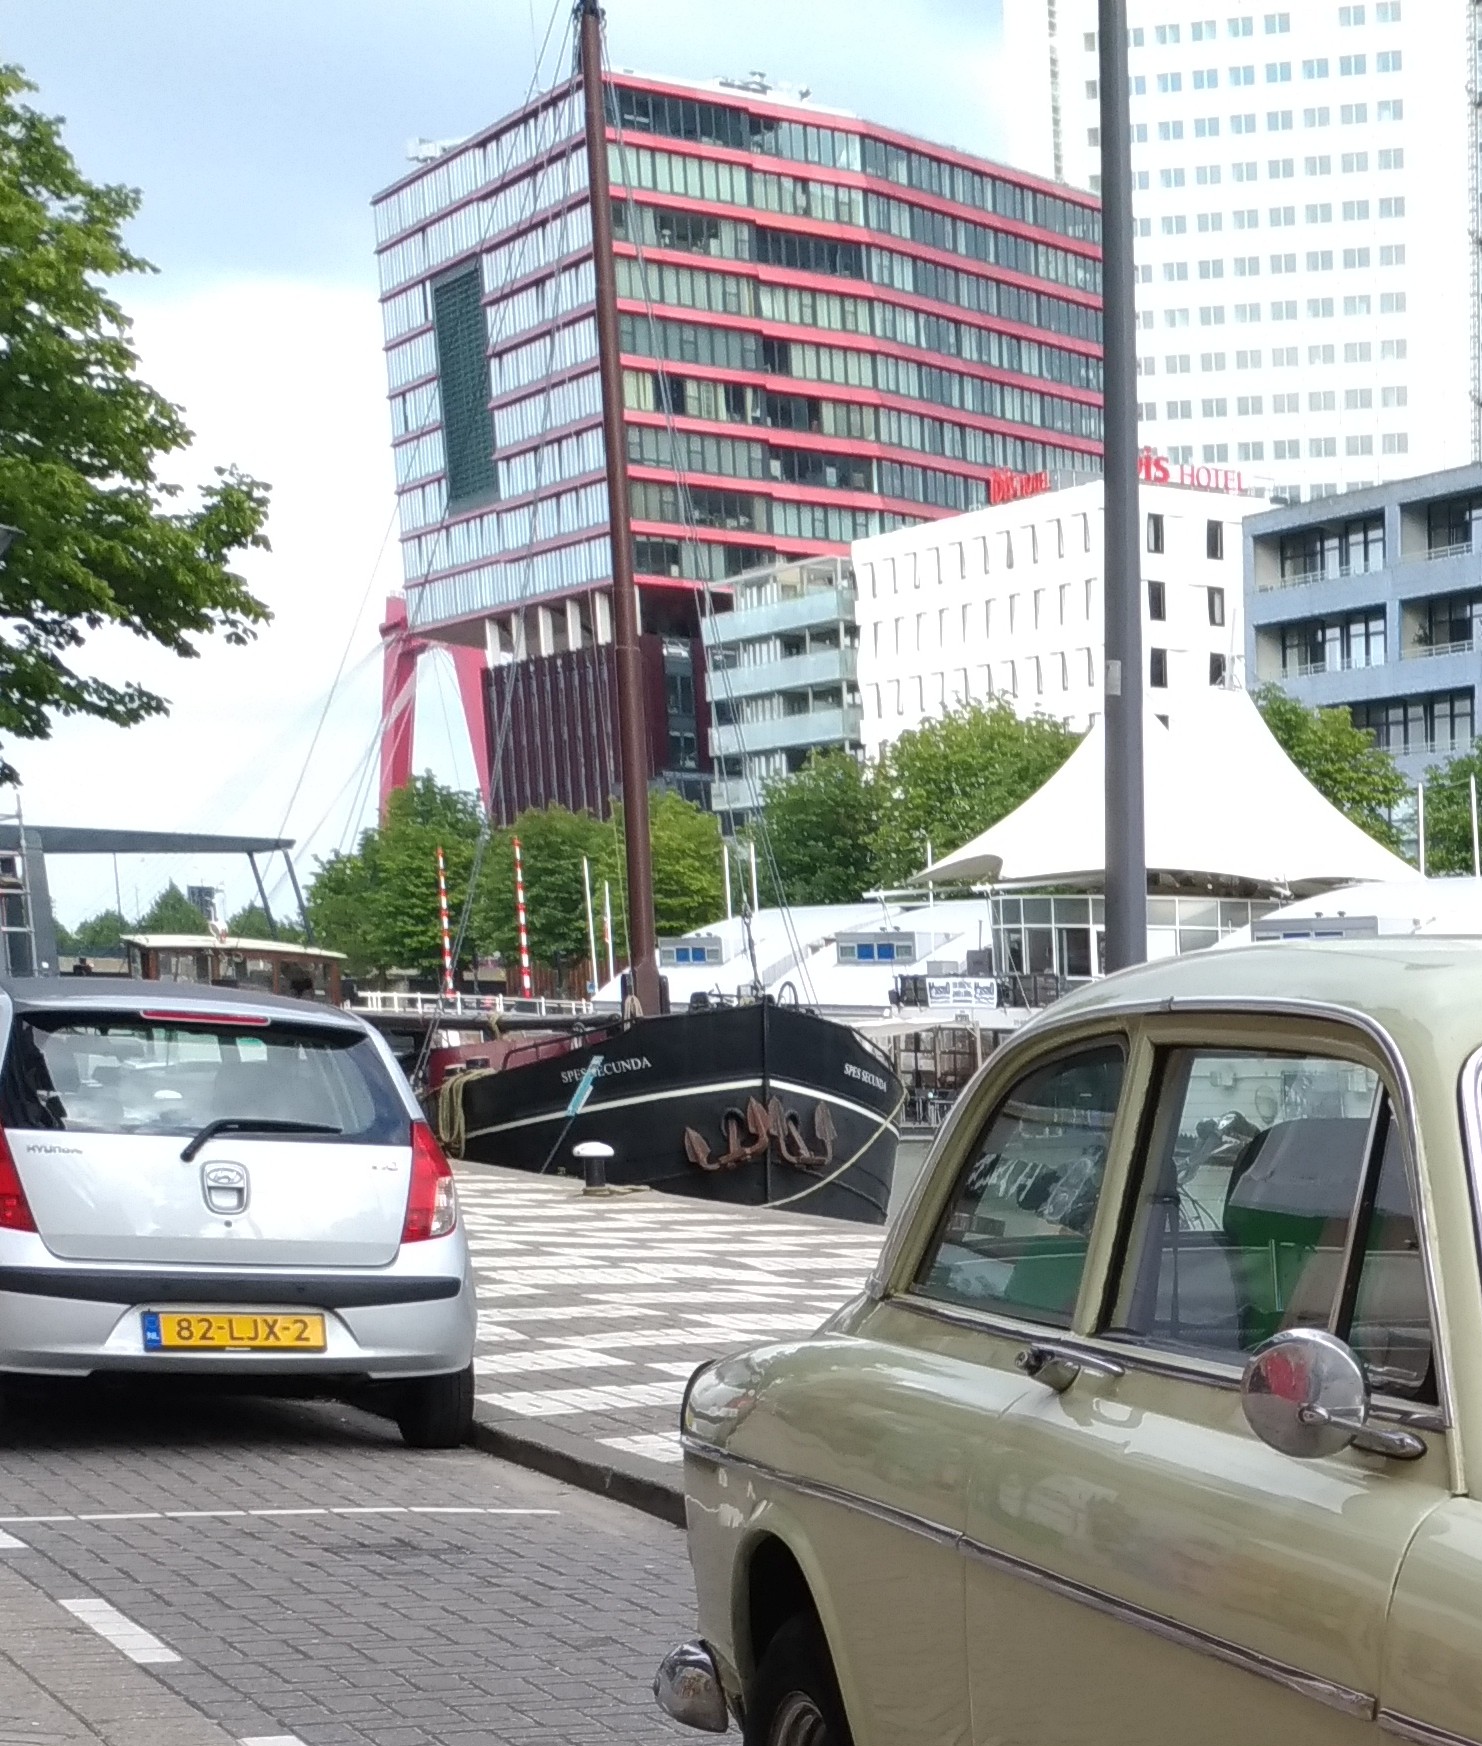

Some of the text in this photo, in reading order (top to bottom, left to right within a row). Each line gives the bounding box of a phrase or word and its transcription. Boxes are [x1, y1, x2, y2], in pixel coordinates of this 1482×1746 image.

[1137, 445, 1244, 492] is HOTEL
[593, 1056, 652, 1078] ECUNDA
[844, 1062, 887, 1093] SPES SECUNDA
[175, 1317, 311, 1343] 82-LJX-2
